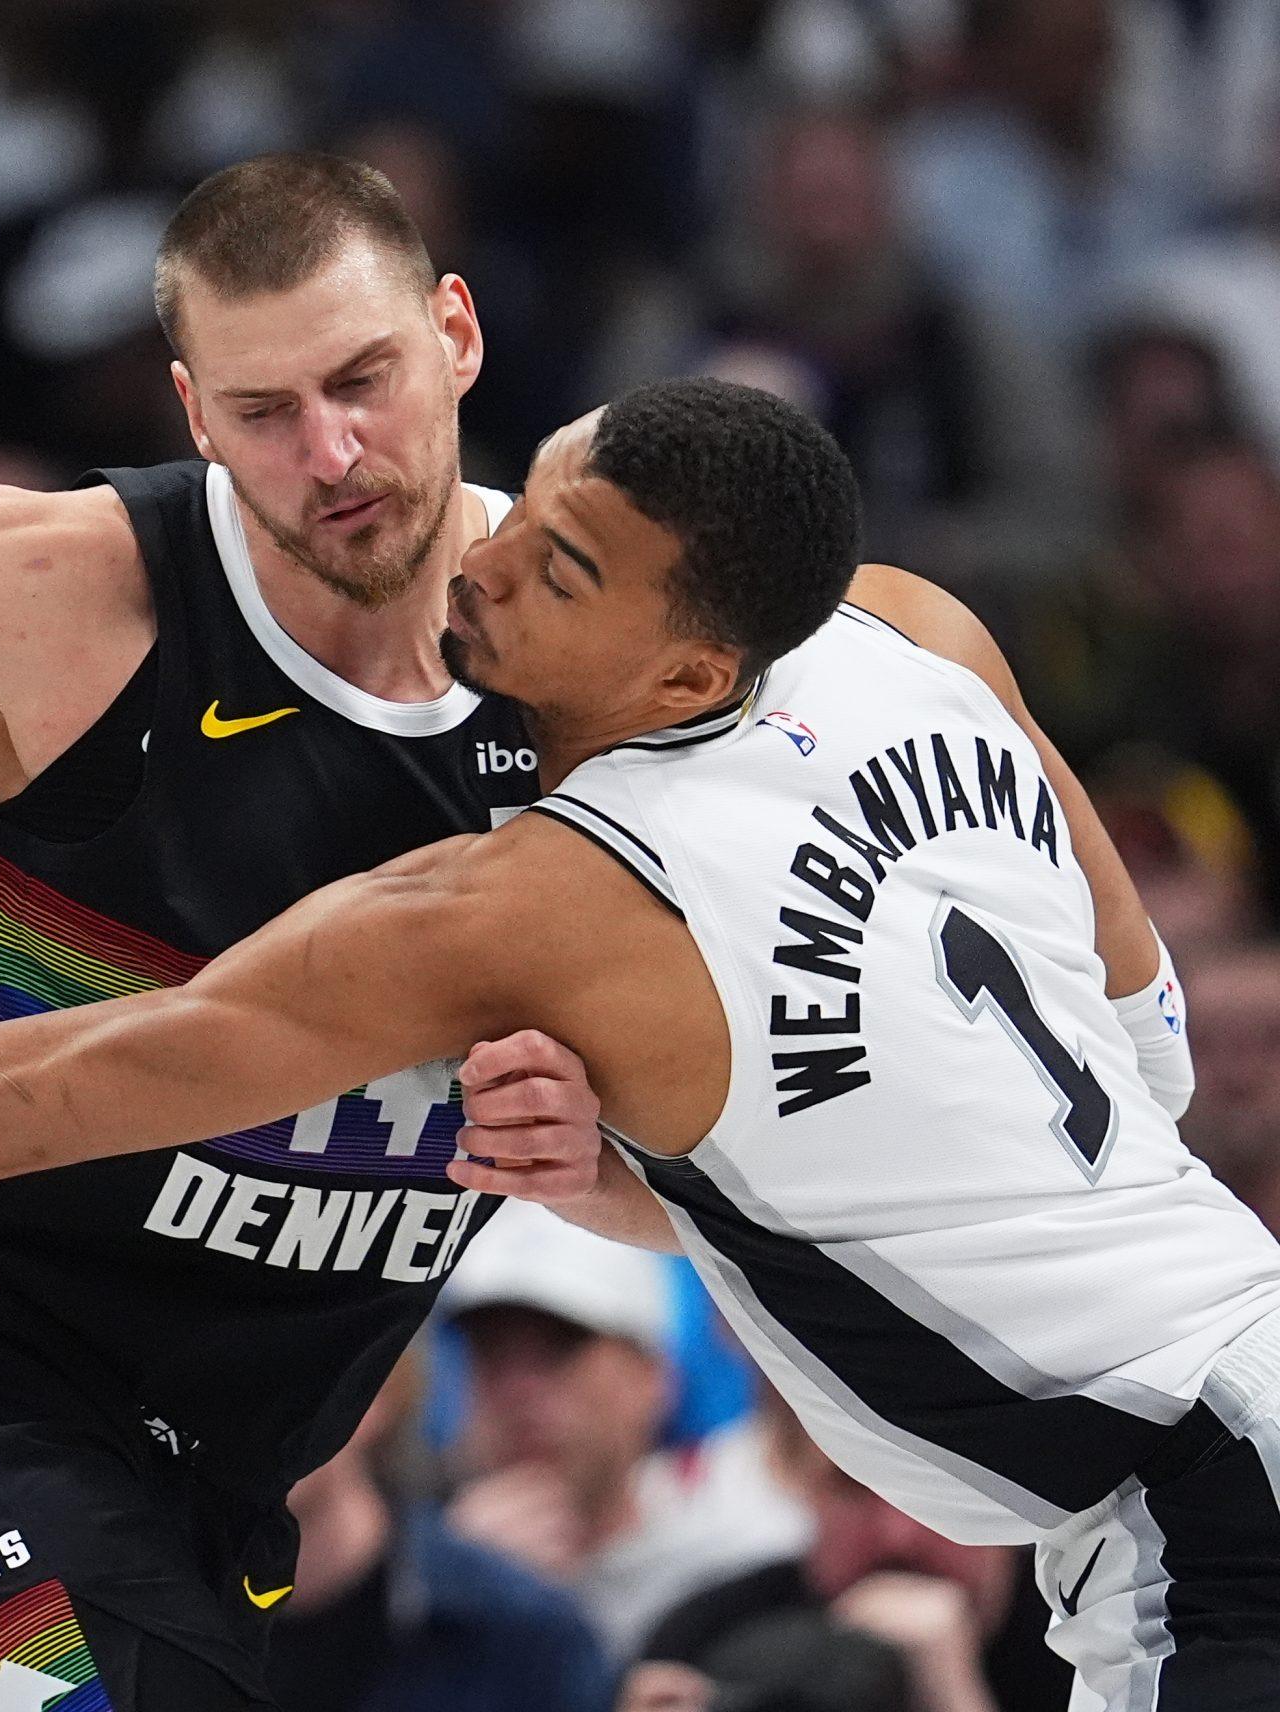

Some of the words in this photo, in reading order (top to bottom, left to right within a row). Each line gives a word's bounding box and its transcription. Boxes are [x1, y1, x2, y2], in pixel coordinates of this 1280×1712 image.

[476, 741, 538, 774] ibo
[770, 733, 1058, 1117] WEMBANYAMA
[929, 891, 1120, 1186] 1
[143, 1152, 481, 1283] DENVER
